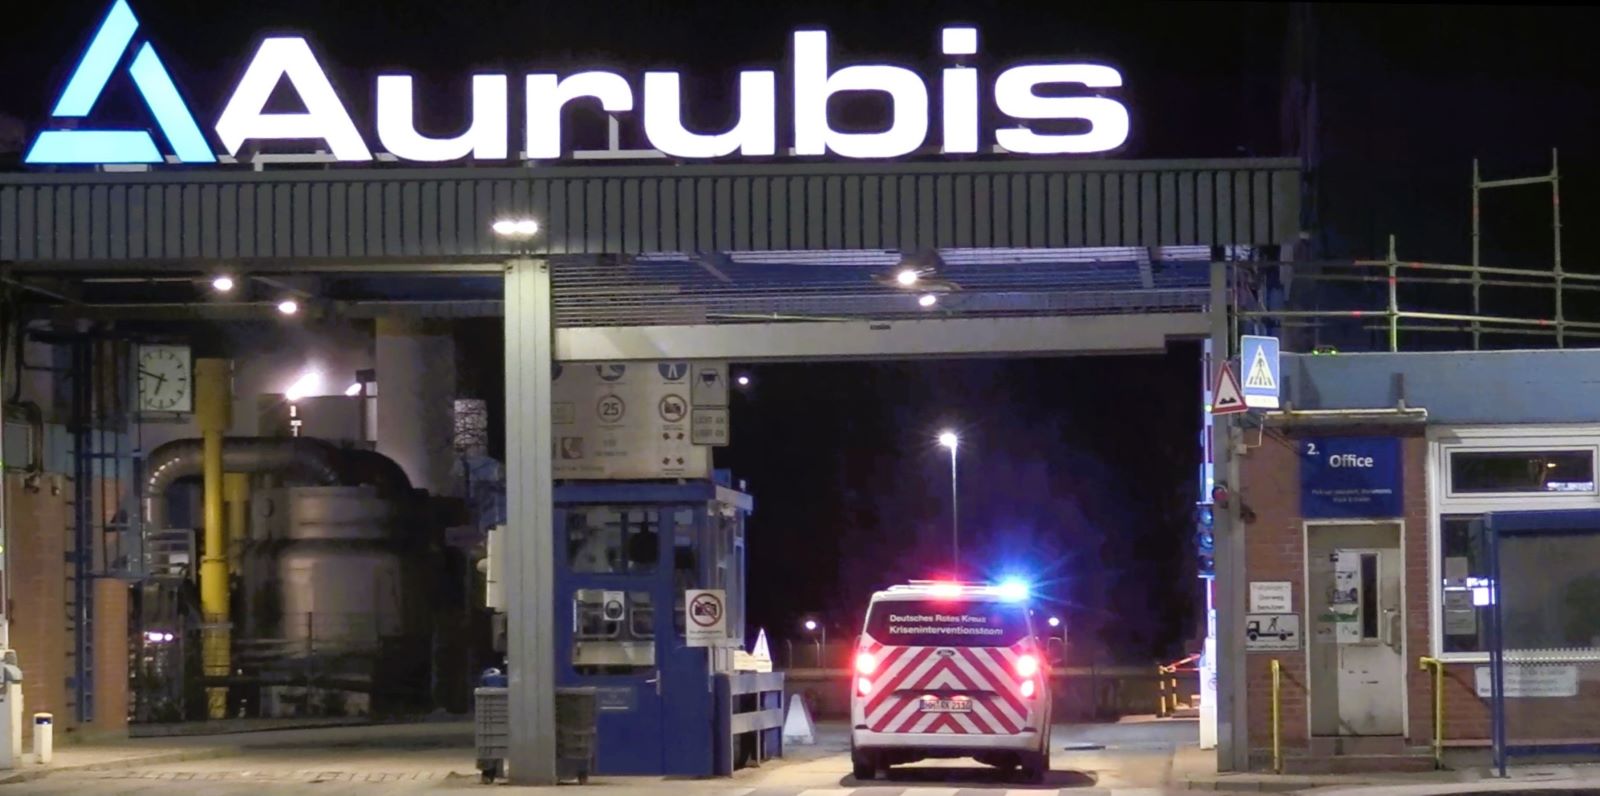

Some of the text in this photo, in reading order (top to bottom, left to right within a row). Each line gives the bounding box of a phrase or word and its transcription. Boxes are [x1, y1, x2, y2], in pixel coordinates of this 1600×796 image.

[215, 28, 1130, 161] Aurubis
[603, 402, 619, 416] 25
[1307, 442, 1320, 455] 2.
[1329, 454, 1374, 468] Office
[889, 614, 987, 624] Deutsches Rotes Kreuz
[889, 625, 1003, 635] Kriseninterventionsteam
